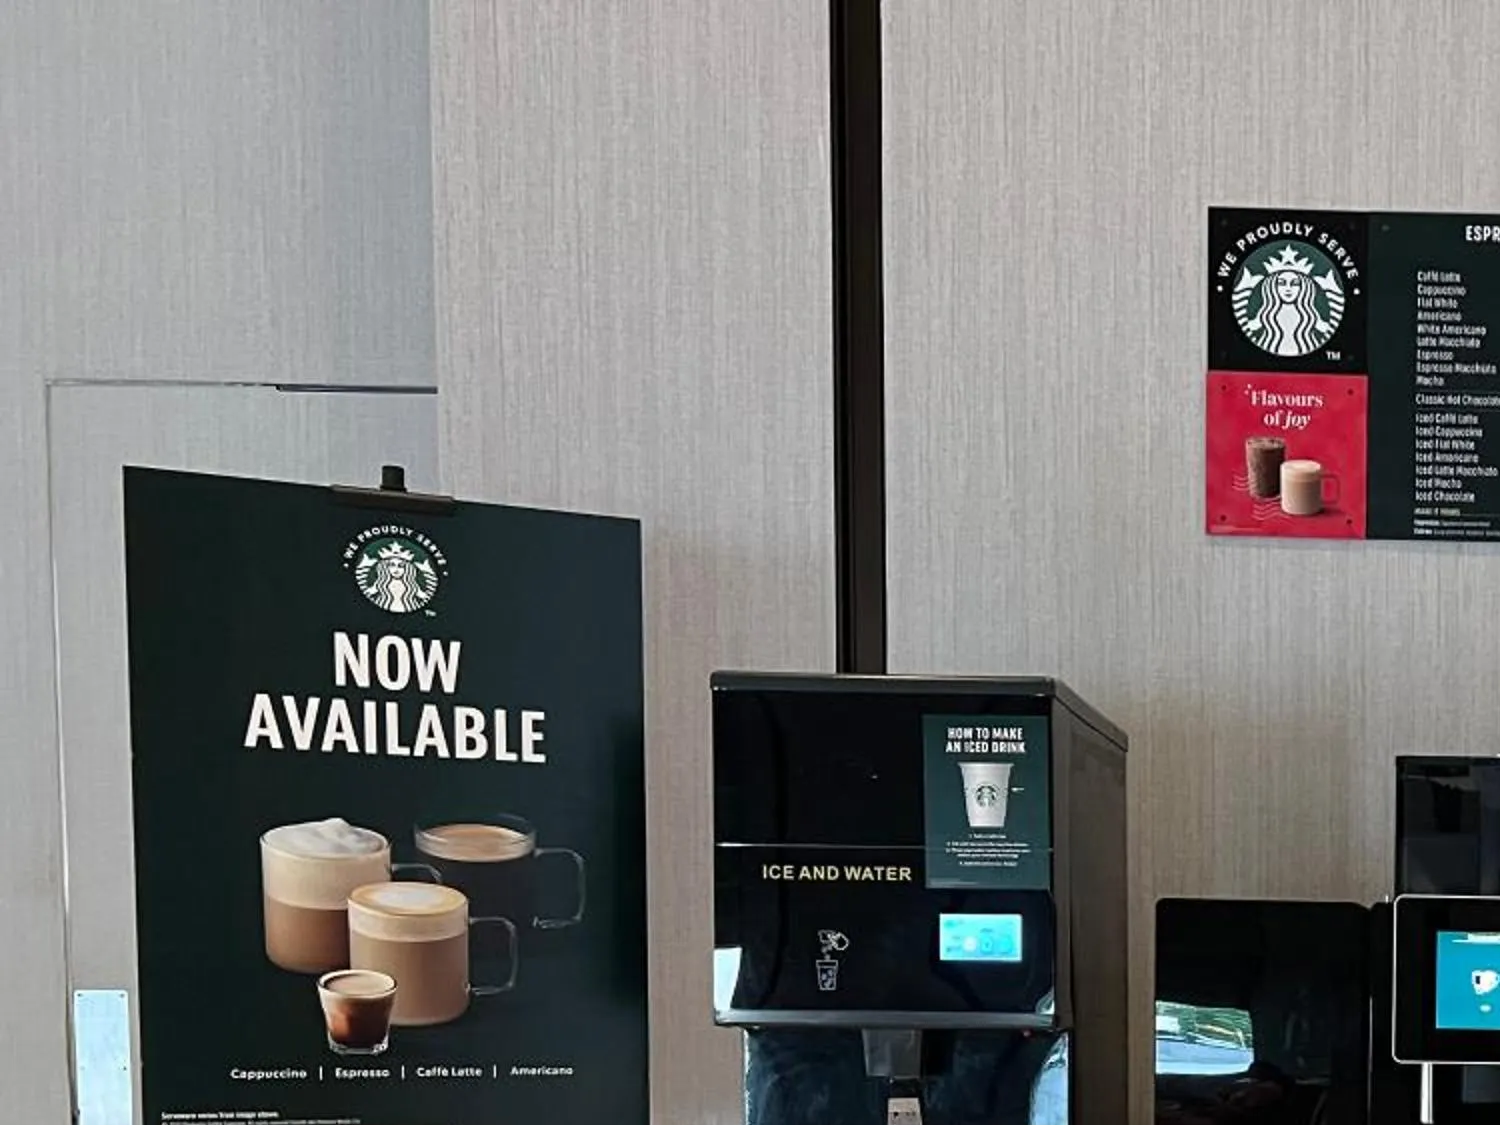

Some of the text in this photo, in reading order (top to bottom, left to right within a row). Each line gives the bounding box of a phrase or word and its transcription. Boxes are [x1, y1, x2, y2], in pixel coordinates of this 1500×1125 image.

[1217, 221, 1359, 279] WE PROUDLY SERVE
[1417, 284, 1467, 297] Cappuccino
[1417, 311, 1462, 322] Americano
[1442, 323, 1487, 336] Americano
[1438, 336, 1481, 348] Macchiato
[1417, 349, 1454, 361] Espresso
[1417, 362, 1453, 374] Espresso
[1454, 362, 1497, 375] Macchiato
[1416, 375, 1444, 387] Mocha
[1251, 389, 1324, 408] Flavours
[1415, 393, 1445, 405] Classic
[1447, 394, 1460, 405] Hot
[1263, 410, 1311, 430] of joy
[1415, 413, 1434, 423] Iced
[1415, 425, 1434, 436] Iced
[1435, 425, 1483, 438] Cappuccino
[1415, 438, 1434, 449] Iced
[1415, 451, 1433, 462] Iced
[1435, 451, 1479, 463] Americano
[1415, 465, 1433, 475] Iced
[1455, 465, 1499, 477] Macchiato
[1415, 478, 1433, 489] Iced
[1434, 478, 1462, 489] Mocha
[1415, 490, 1433, 501] Iced
[1434, 490, 1475, 503] Chocolate
[344, 525, 447, 565] WE PROUDLY SERVE
[333, 631, 461, 694] NOW
[243, 693, 547, 764] AVAILABLE
[947, 727, 1023, 740] HOW TO MAKE
[945, 741, 1026, 753] AN ICED DRINK
[762, 864, 795, 880] ICE
[799, 865, 840, 881] AND
[844, 866, 912, 882] WATER
[230, 1067, 308, 1081] Cappuccino
[335, 1067, 391, 1079] Espresso
[416, 1065, 483, 1078] Caffè Latte
[510, 1066, 574, 1077] Americano
